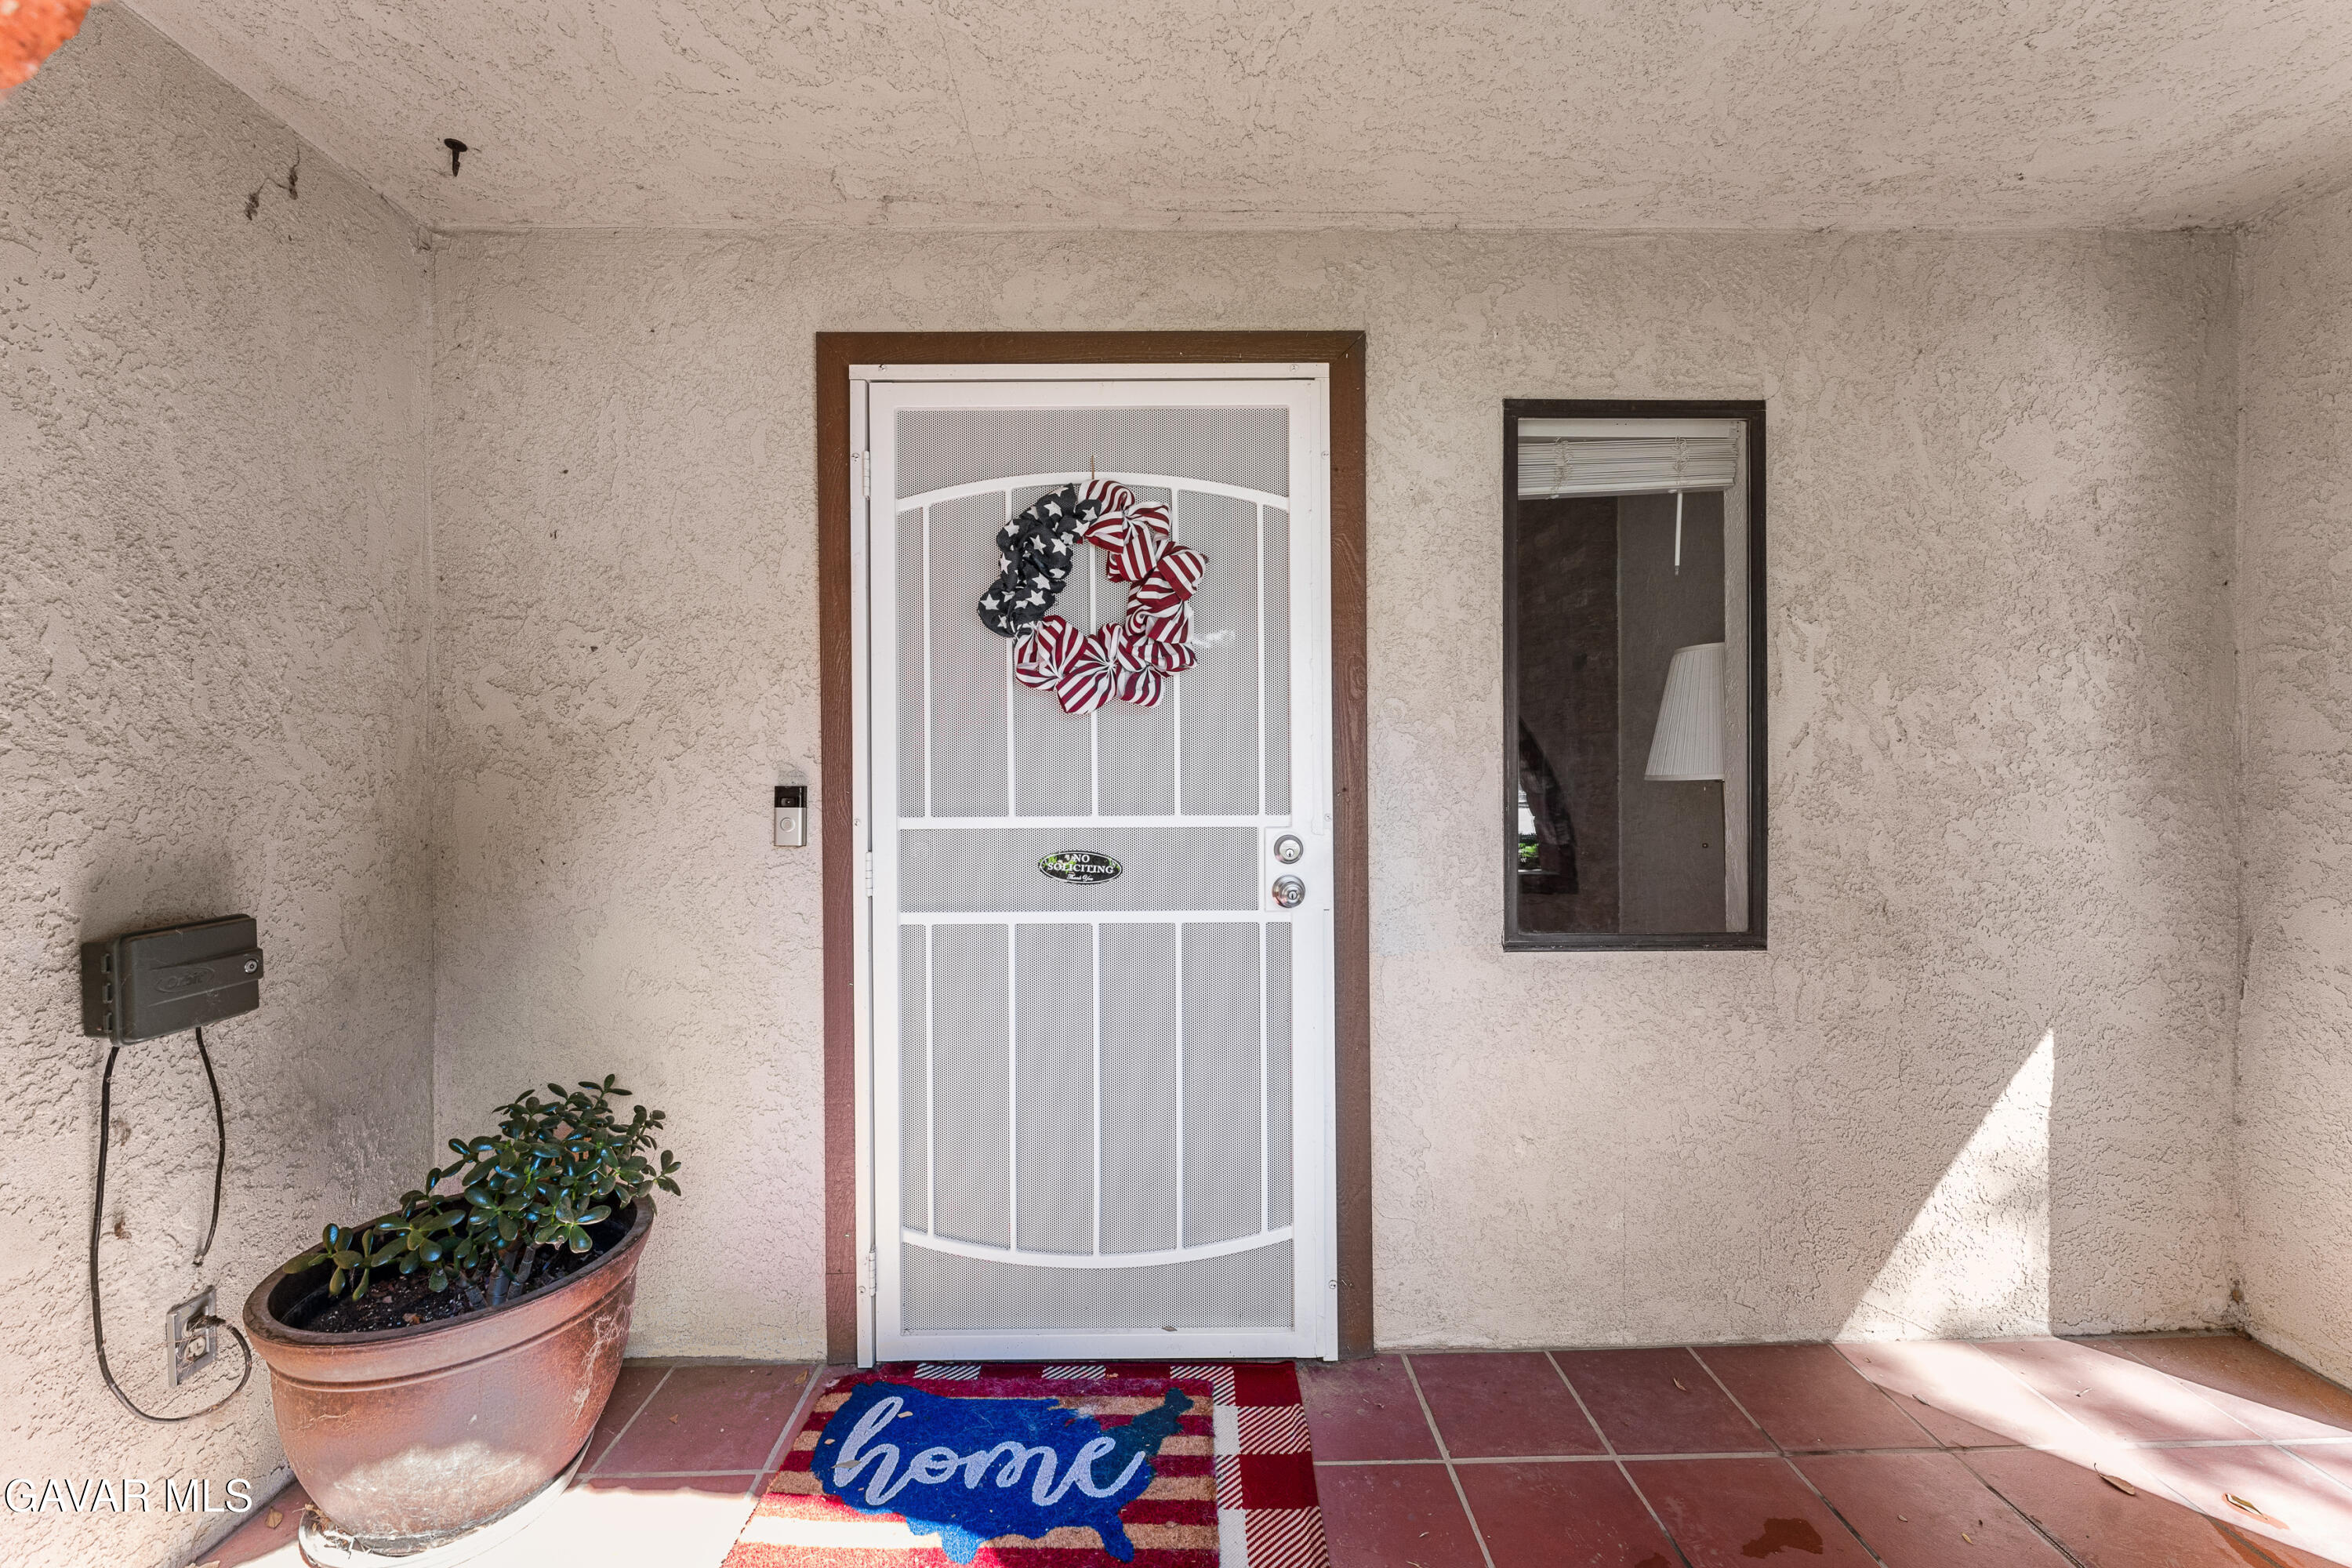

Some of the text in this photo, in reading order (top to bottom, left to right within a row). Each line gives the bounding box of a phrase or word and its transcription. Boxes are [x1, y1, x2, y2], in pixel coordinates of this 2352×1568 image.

[1073, 854, 1091, 863] NO
[1047, 862, 1114, 874] SOLICITING
[833, 1396, 1145, 1507] home
